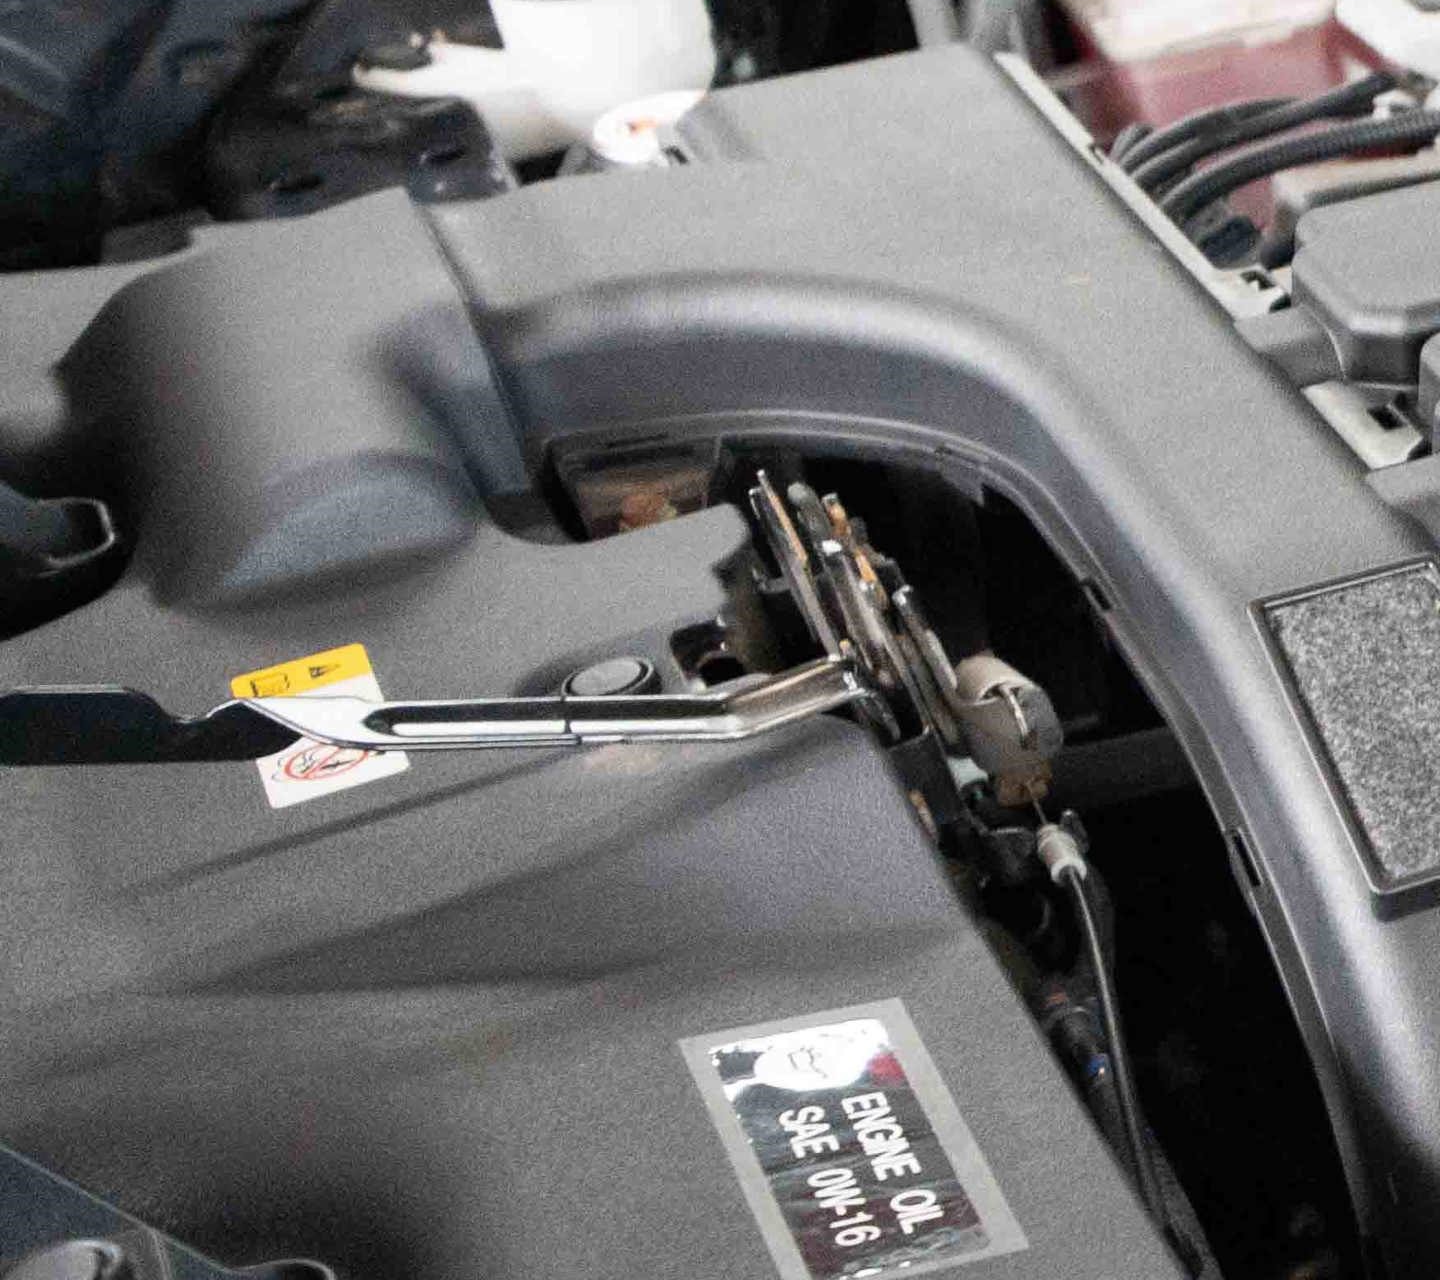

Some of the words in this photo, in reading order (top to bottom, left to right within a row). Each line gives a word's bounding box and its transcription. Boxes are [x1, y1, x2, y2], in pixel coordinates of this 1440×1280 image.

[779, 1104, 840, 1160] SAE
[842, 1091, 922, 1182] ENGINE
[888, 1189, 946, 1236] OIL
[807, 1170, 882, 1247] 0W-16
